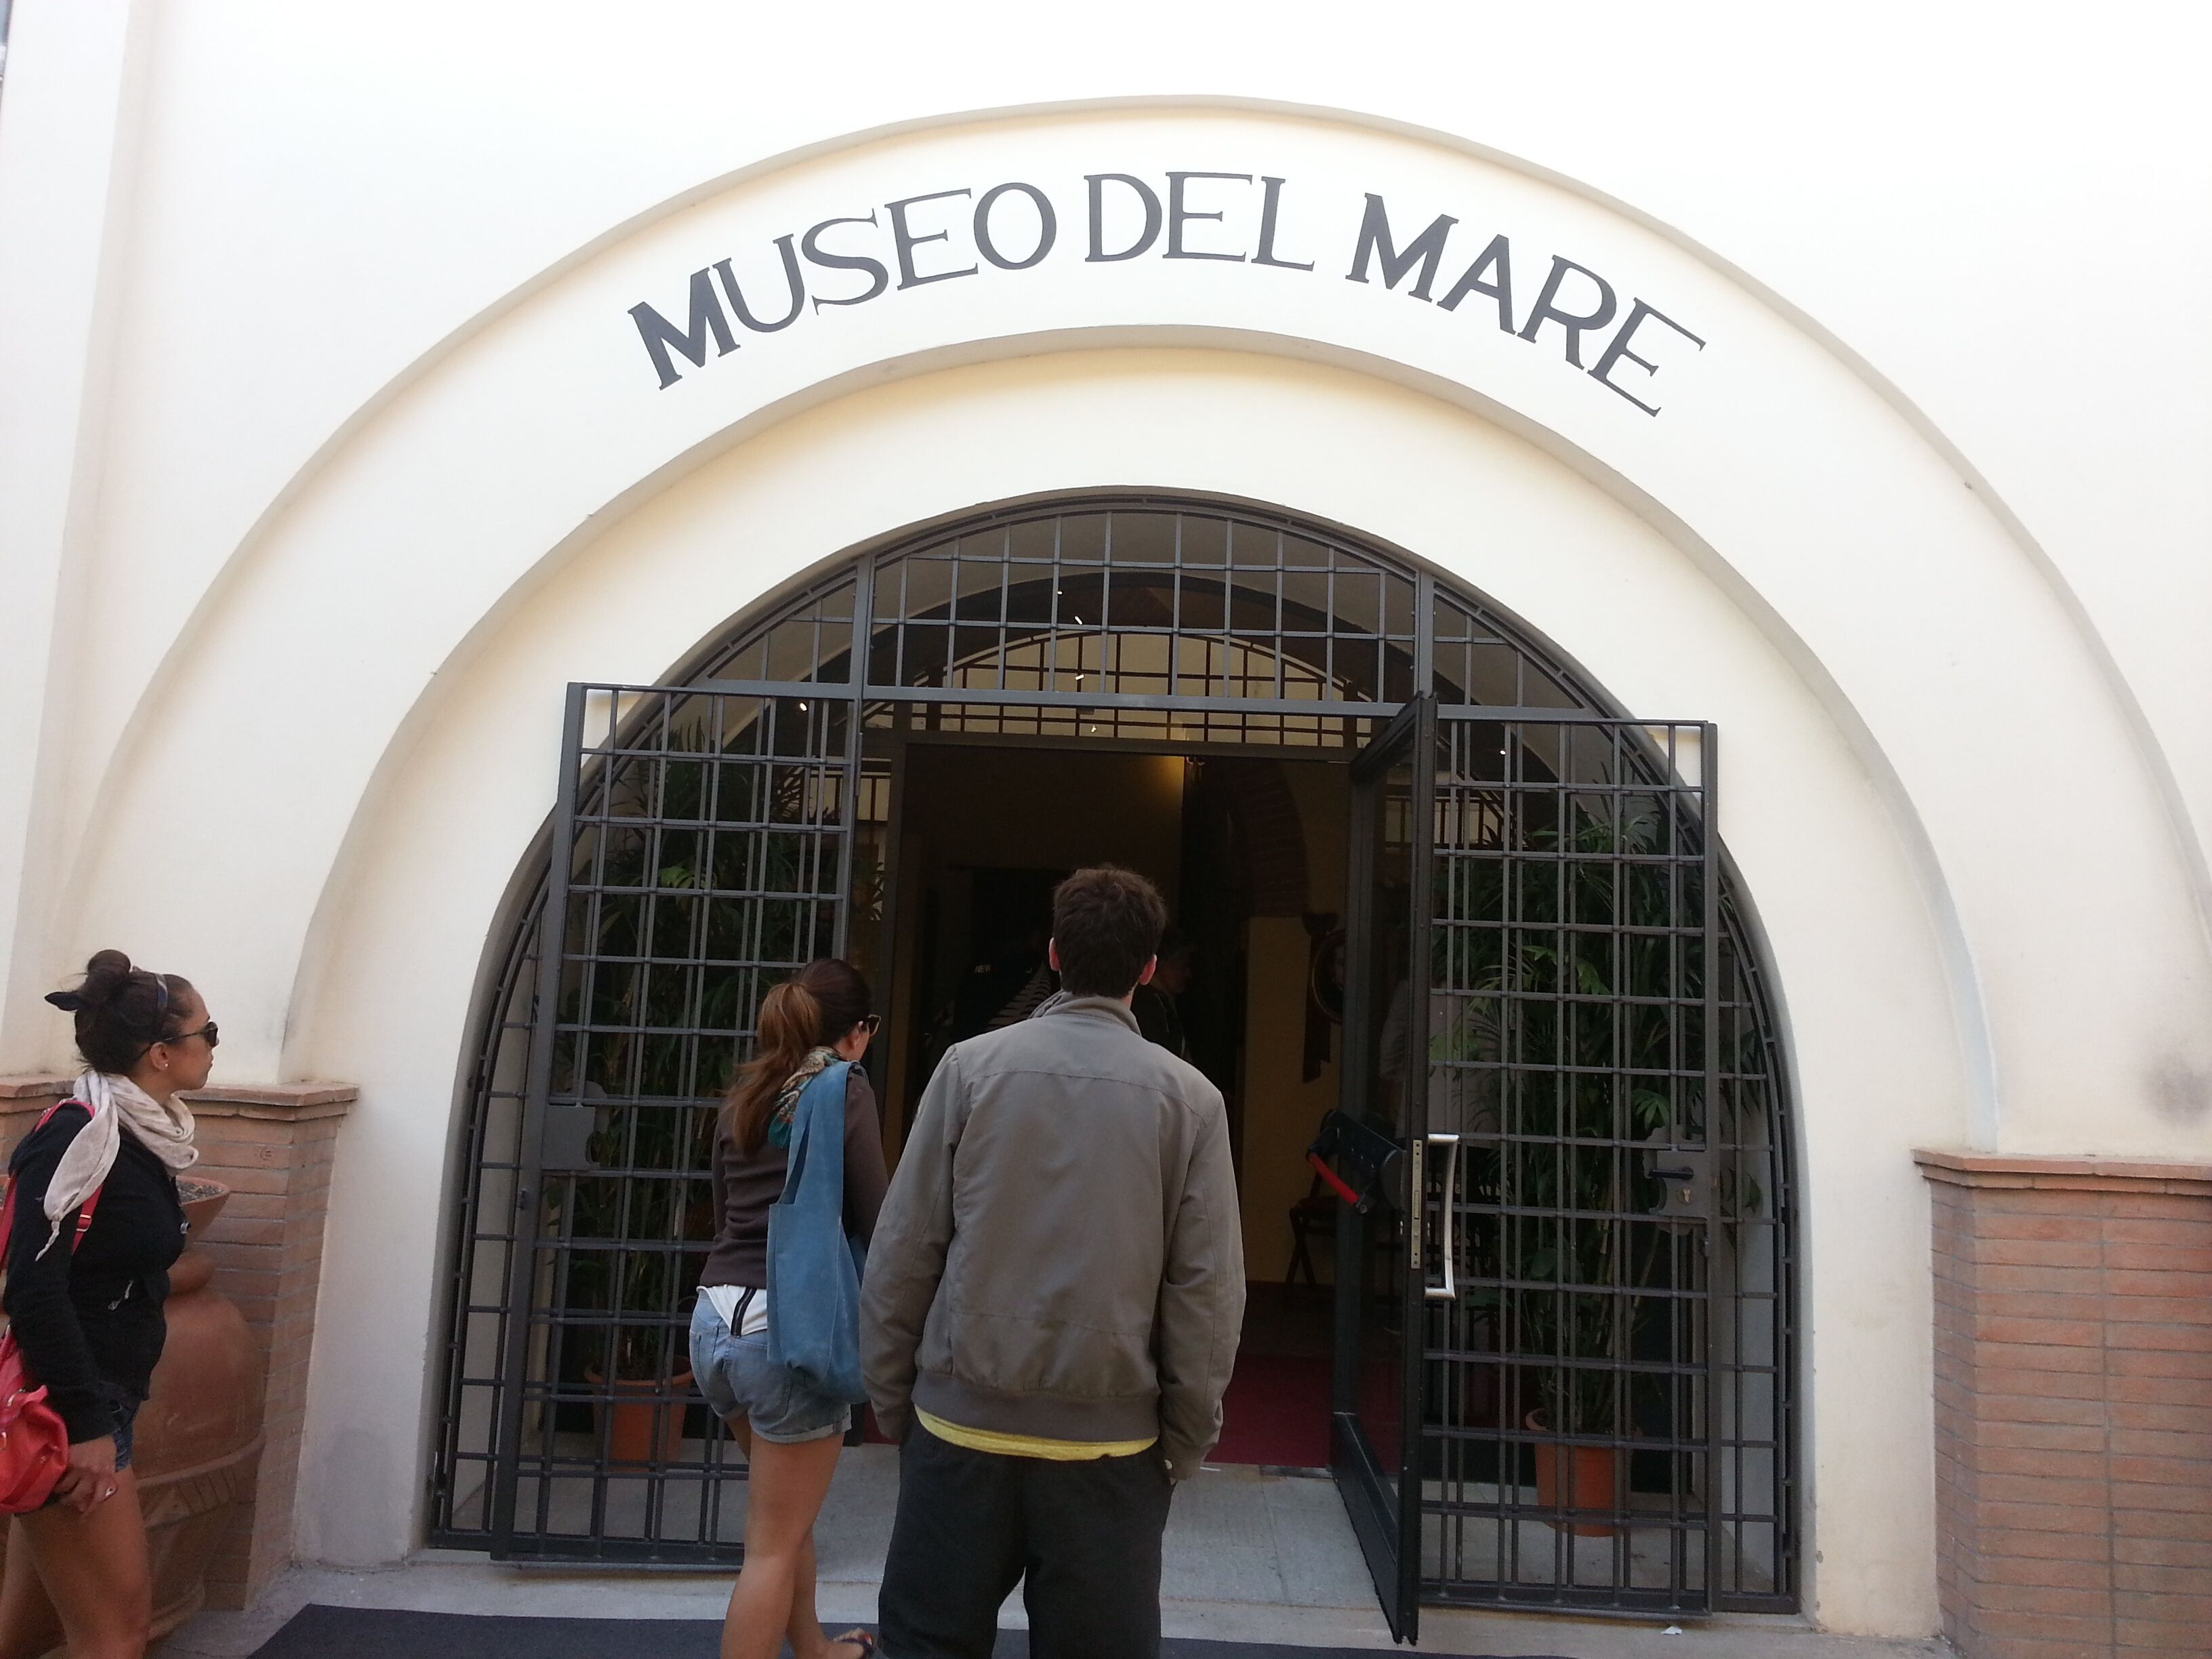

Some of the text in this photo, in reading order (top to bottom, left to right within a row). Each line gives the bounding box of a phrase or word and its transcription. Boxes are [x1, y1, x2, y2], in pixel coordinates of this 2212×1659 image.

[628, 174, 1705, 417] MUSEO DEL MARE
